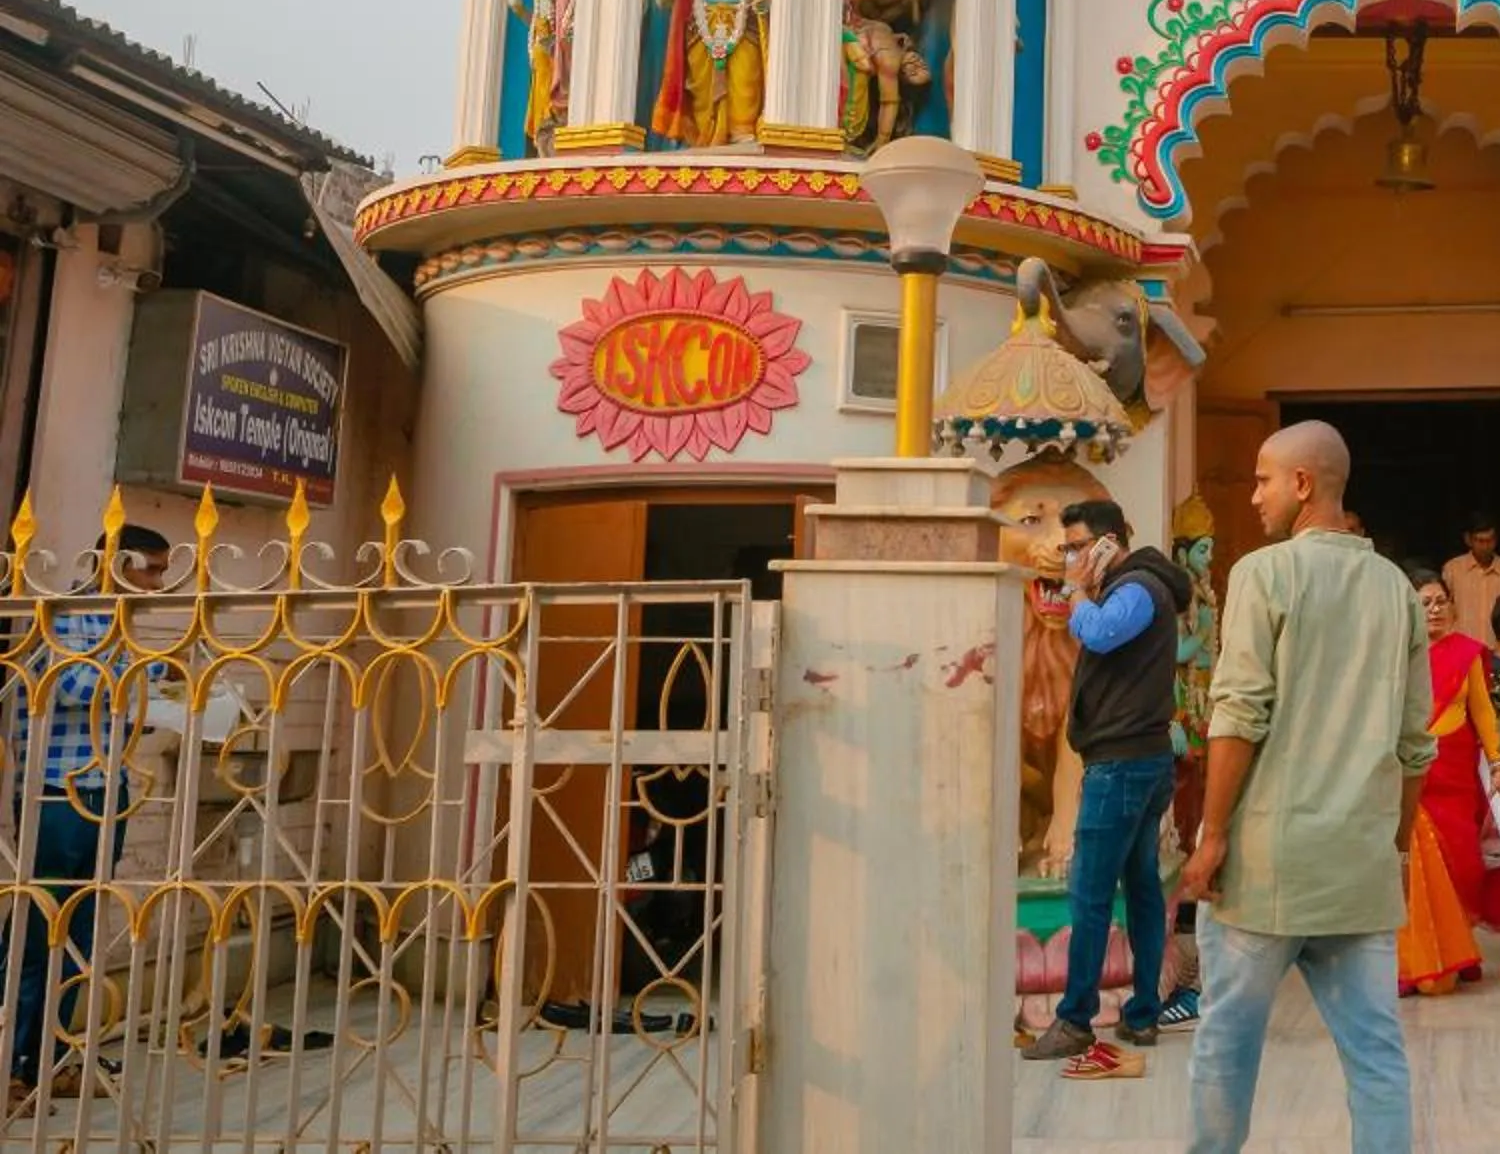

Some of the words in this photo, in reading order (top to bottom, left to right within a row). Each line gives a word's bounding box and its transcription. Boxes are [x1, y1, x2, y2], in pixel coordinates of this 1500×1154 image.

[200, 338, 219, 376] SRI
[221, 330, 266, 367] KRISHNA
[301, 351, 339, 409] SOCIETY
[602, 321, 752, 407] ISKCON
[193, 393, 237, 441] Iskcon
[240, 403, 281, 459] Temple
[283, 414, 335, 474] (Original)
